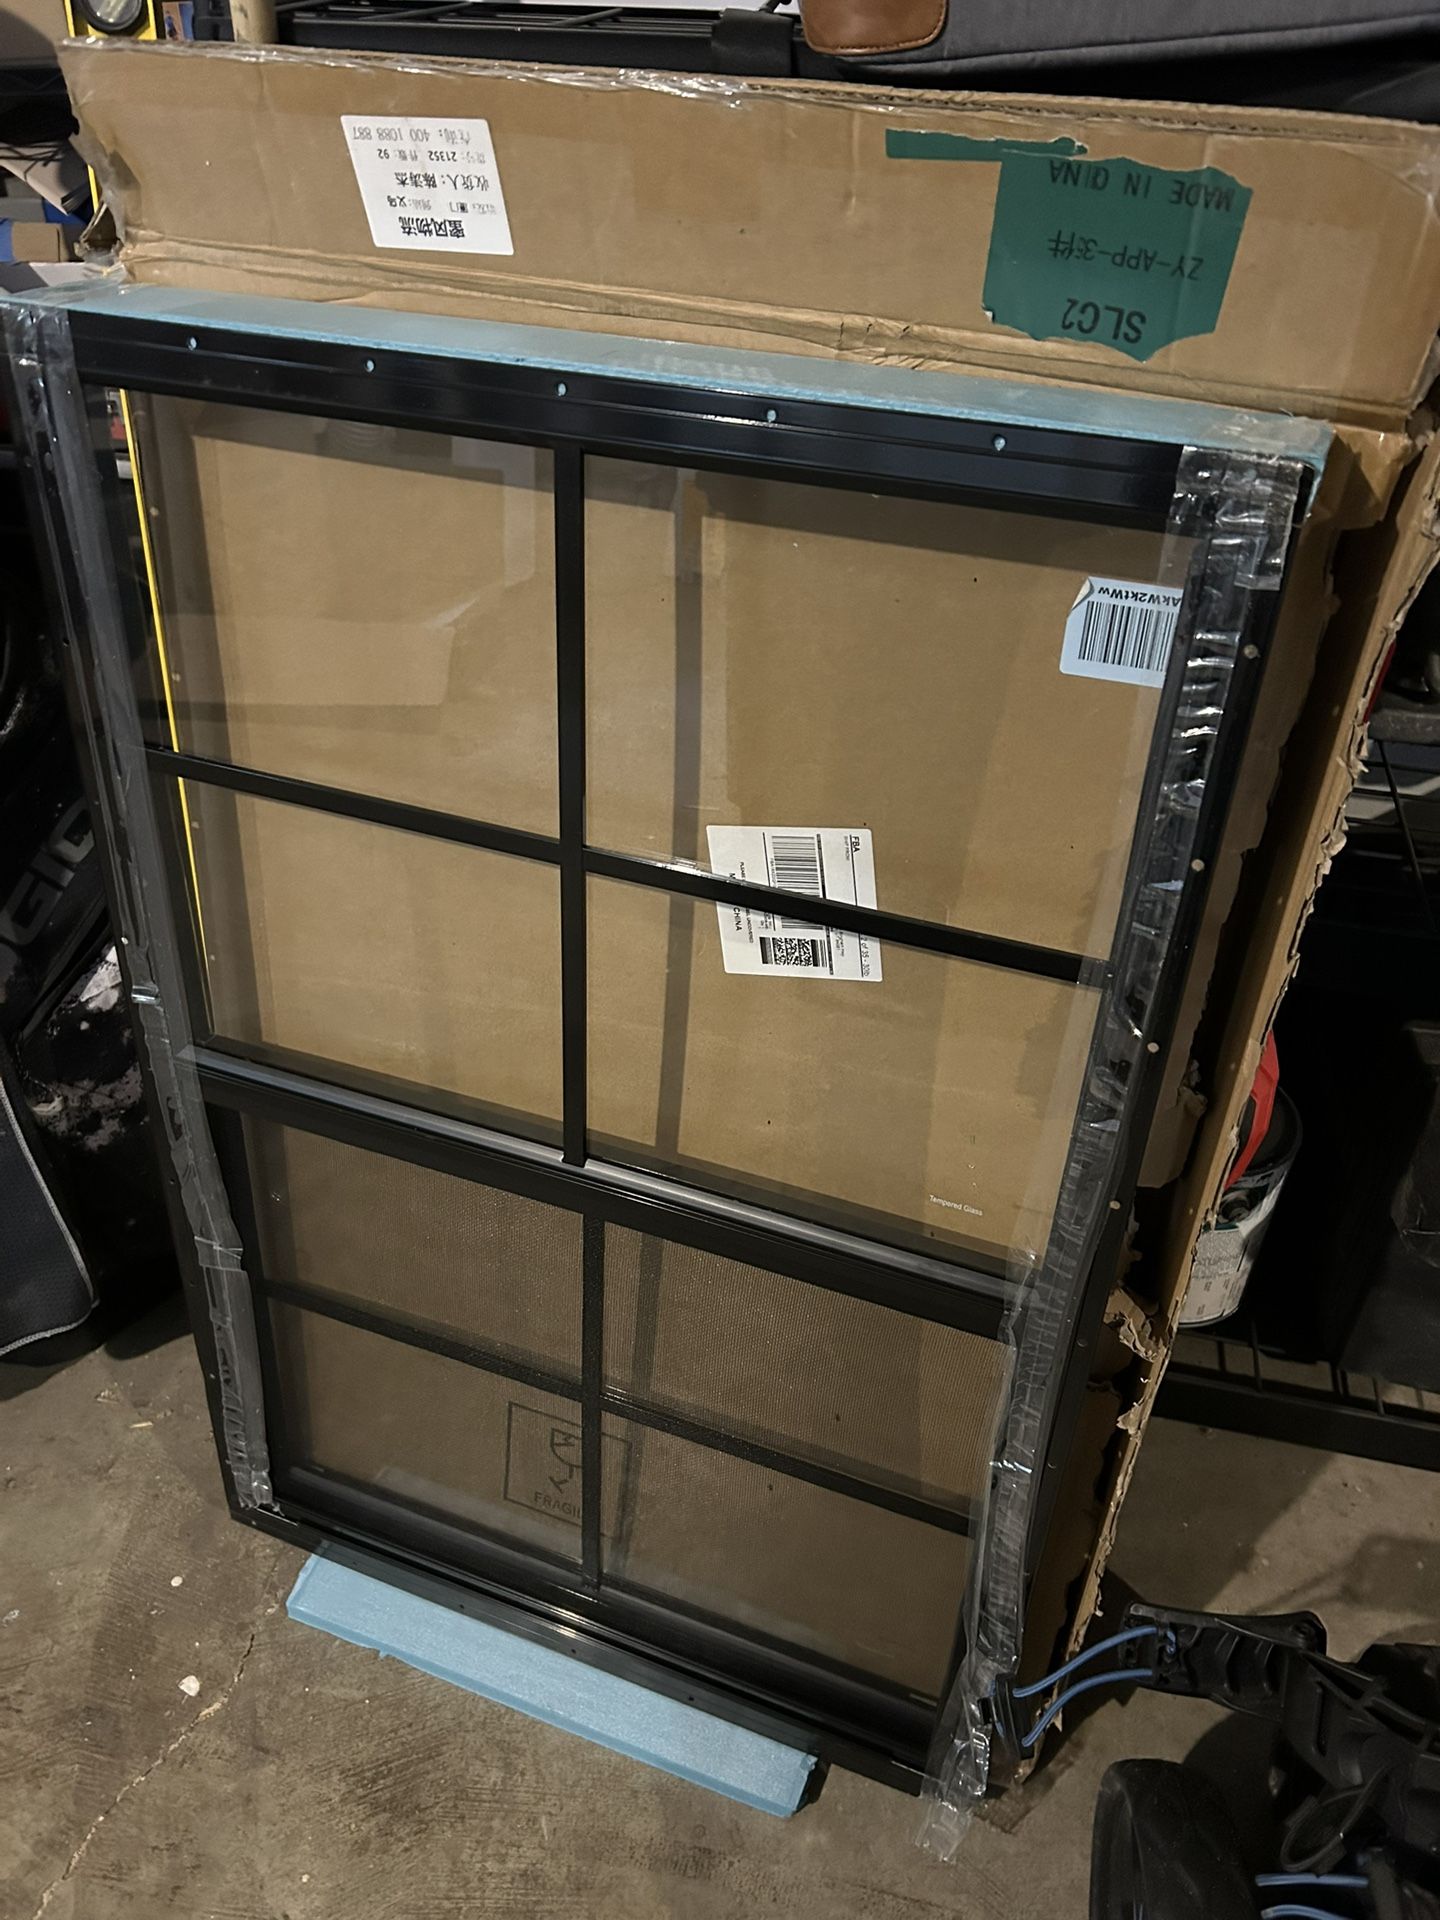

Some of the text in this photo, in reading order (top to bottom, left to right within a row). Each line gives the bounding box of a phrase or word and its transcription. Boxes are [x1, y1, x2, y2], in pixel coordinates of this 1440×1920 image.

[351, 126, 372, 141] 887
[376, 127, 403, 142] 1088
[409, 129, 430, 143] 400
[377, 148, 390, 160] 92
[427, 150, 457, 162] 21352
[1123, 172, 1152, 200] IN
[1169, 178, 1236, 213] MADE
[398, 216, 465, 238] 蜜风物流
[852, 836, 860, 853] FBA
[733, 907, 743, 931] CHINA
[929, 1194, 983, 1216] Tempered Glass
